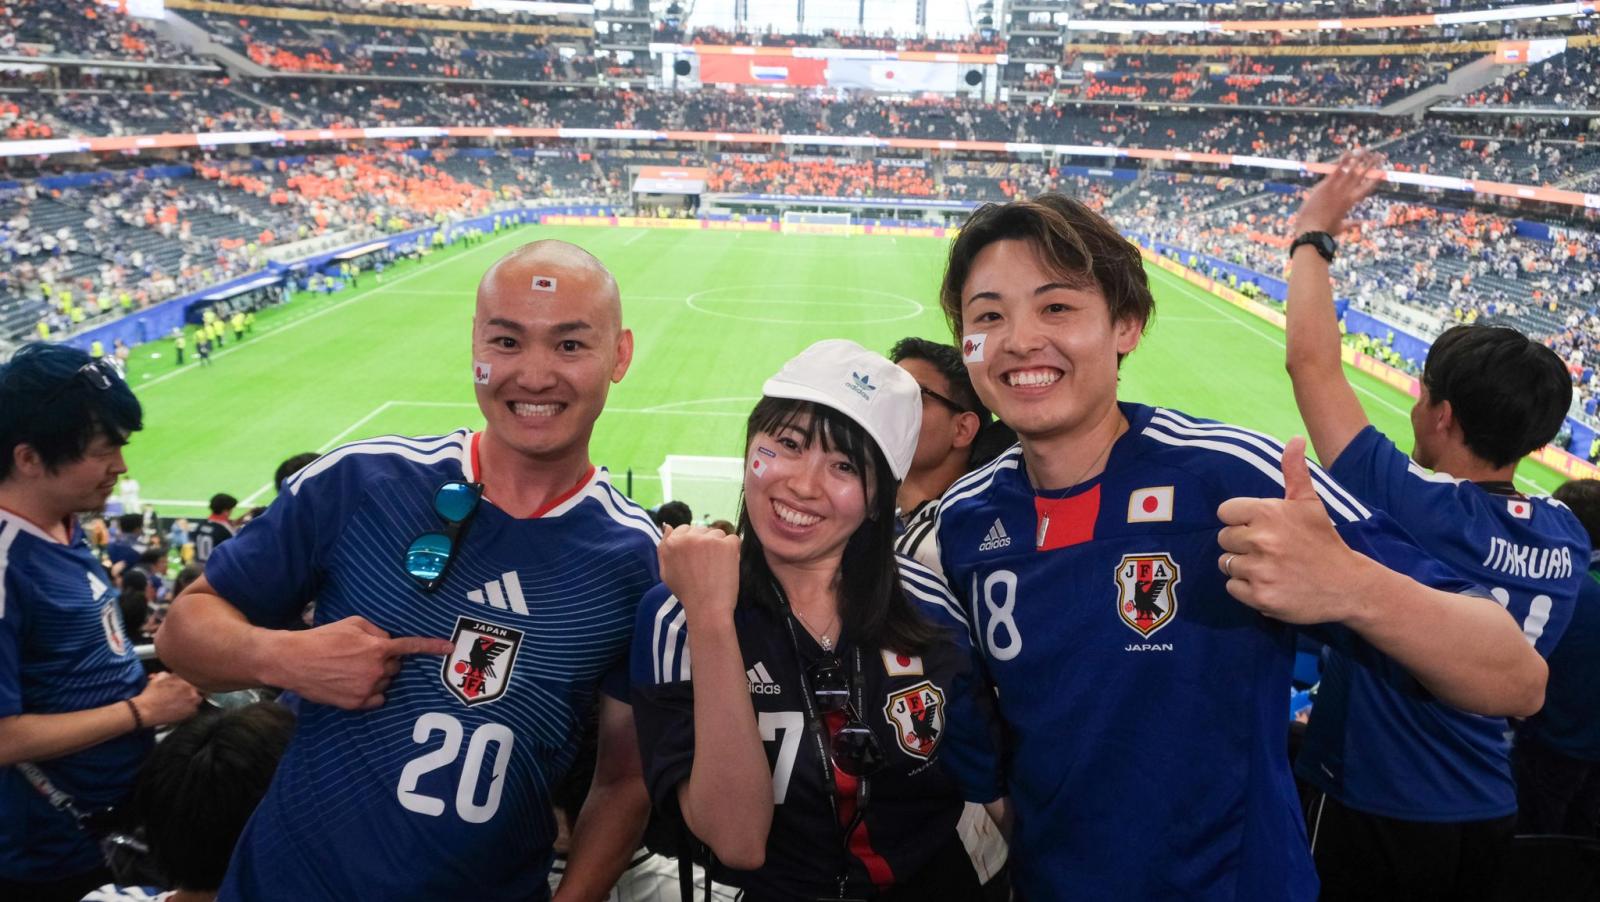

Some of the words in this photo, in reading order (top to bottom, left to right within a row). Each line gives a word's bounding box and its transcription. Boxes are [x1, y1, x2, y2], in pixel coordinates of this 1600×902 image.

[978, 536, 1011, 552] adidas
[1483, 536, 1573, 579] ITAKURA
[1125, 564, 1167, 579] JFA
[972, 569, 1022, 661] 18
[473, 622, 508, 637] JAPAN
[1124, 642, 1173, 652] JAPAN
[457, 676, 486, 694] JFA
[747, 681, 781, 695] idas
[896, 692, 935, 714] JFA
[396, 712, 515, 824] 20
